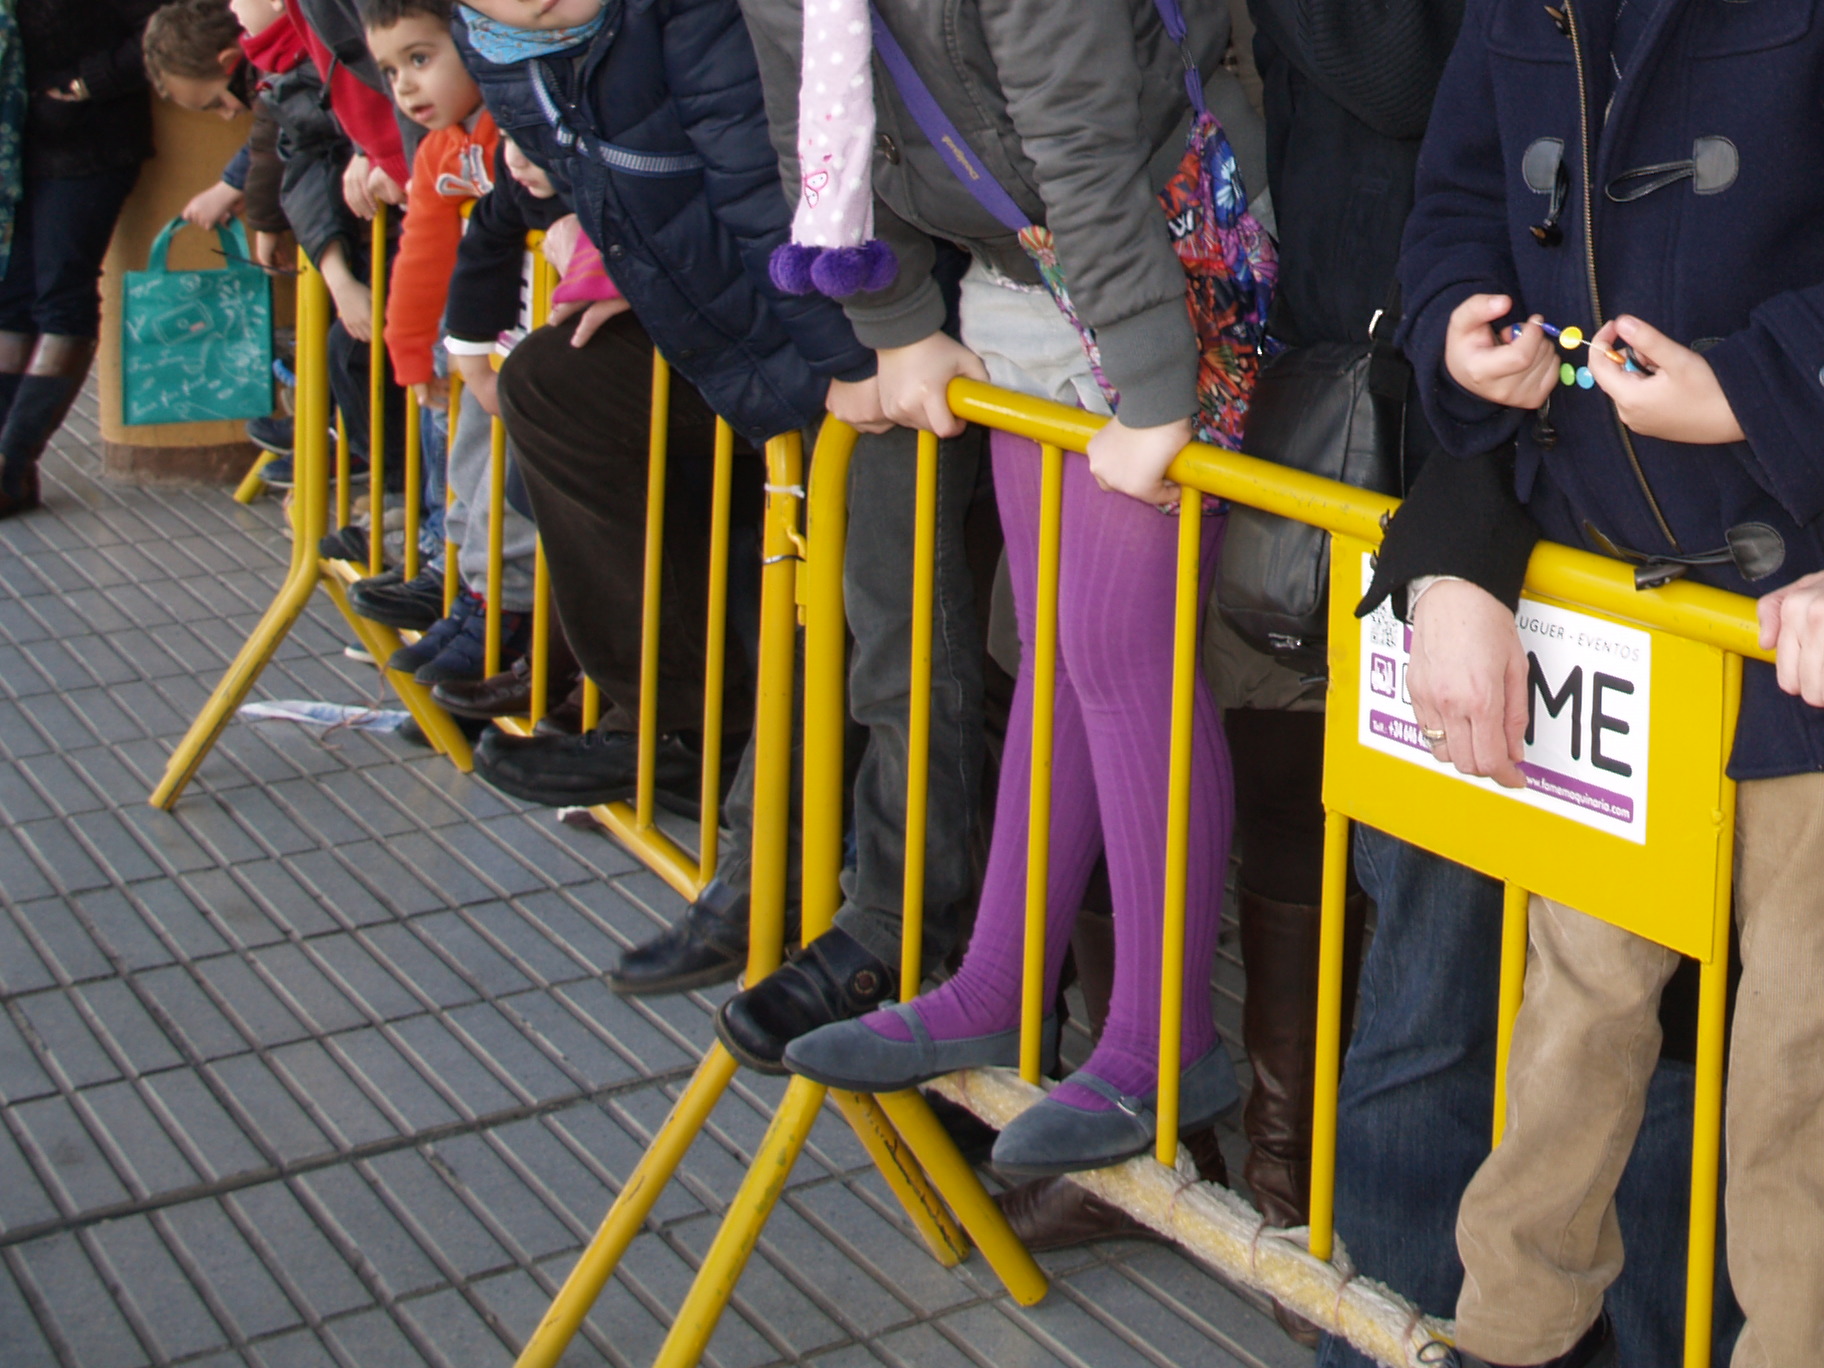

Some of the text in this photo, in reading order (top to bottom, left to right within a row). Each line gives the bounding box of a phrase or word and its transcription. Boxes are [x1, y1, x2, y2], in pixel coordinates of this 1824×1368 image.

[1516, 615, 1640, 663] UGUER EVENTOS
[1525, 650, 1635, 778] ME
